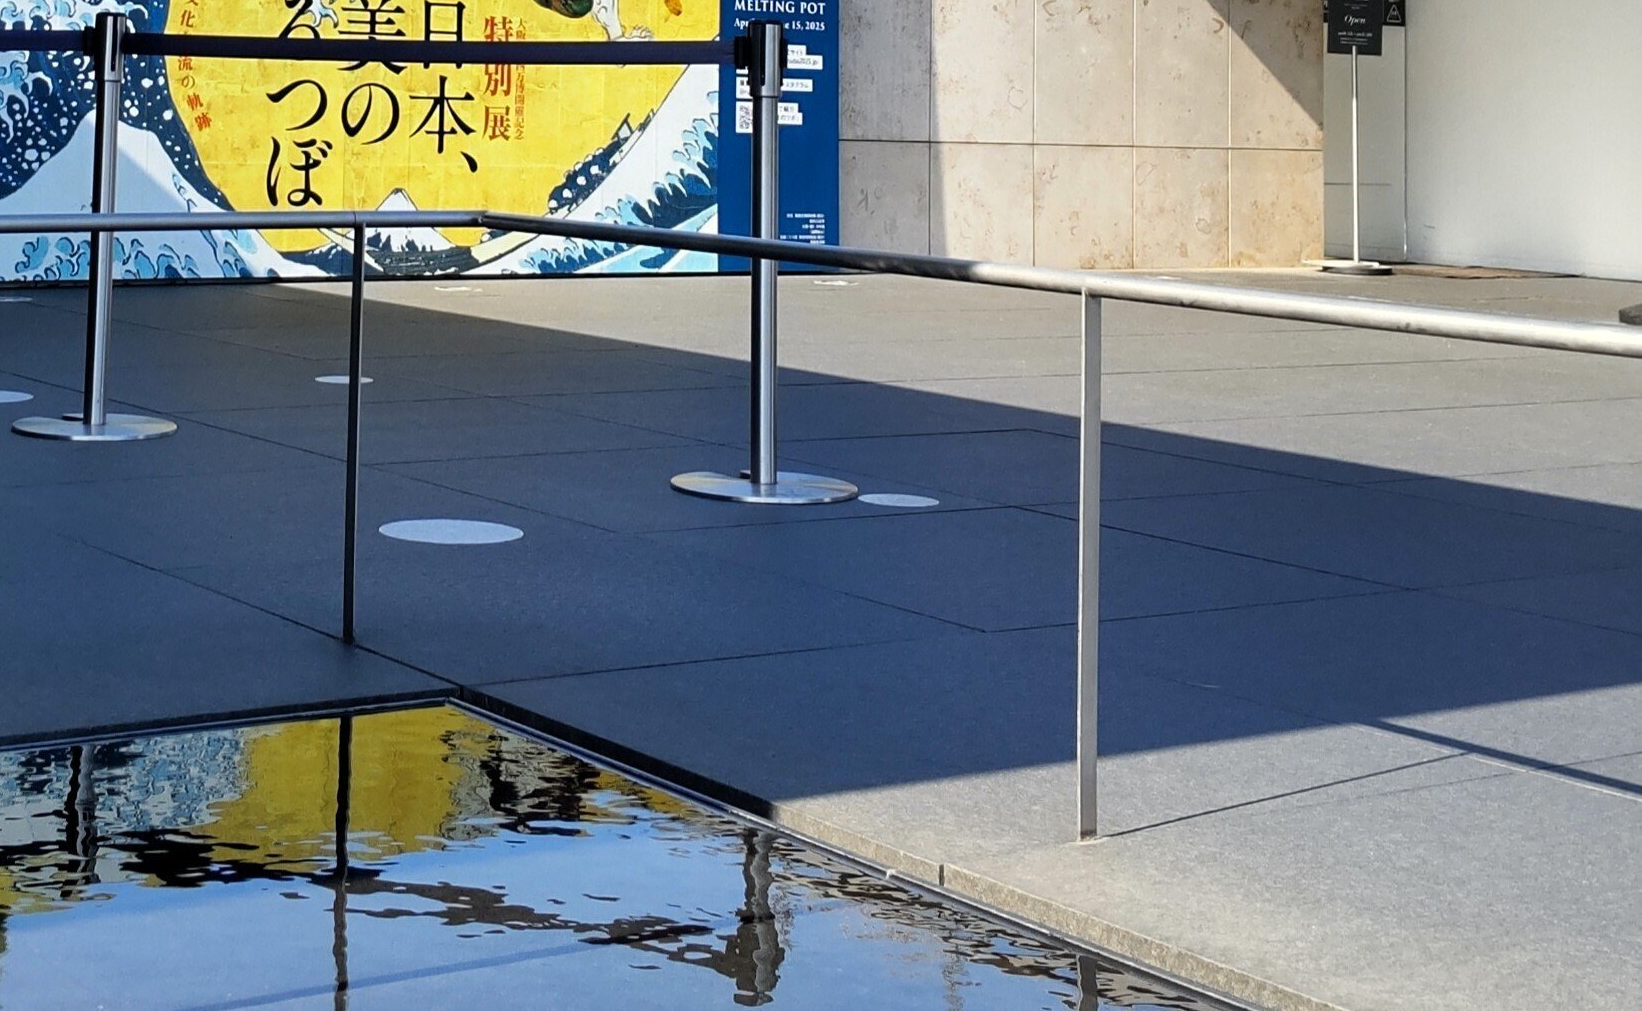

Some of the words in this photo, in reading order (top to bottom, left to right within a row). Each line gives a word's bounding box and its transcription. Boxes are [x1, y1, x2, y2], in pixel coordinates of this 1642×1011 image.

[800, 1, 826, 16] POT
[734, 18, 755, 31] Apr
[805, 21, 825, 32] 2025
[482, 15, 513, 142] 特別展
